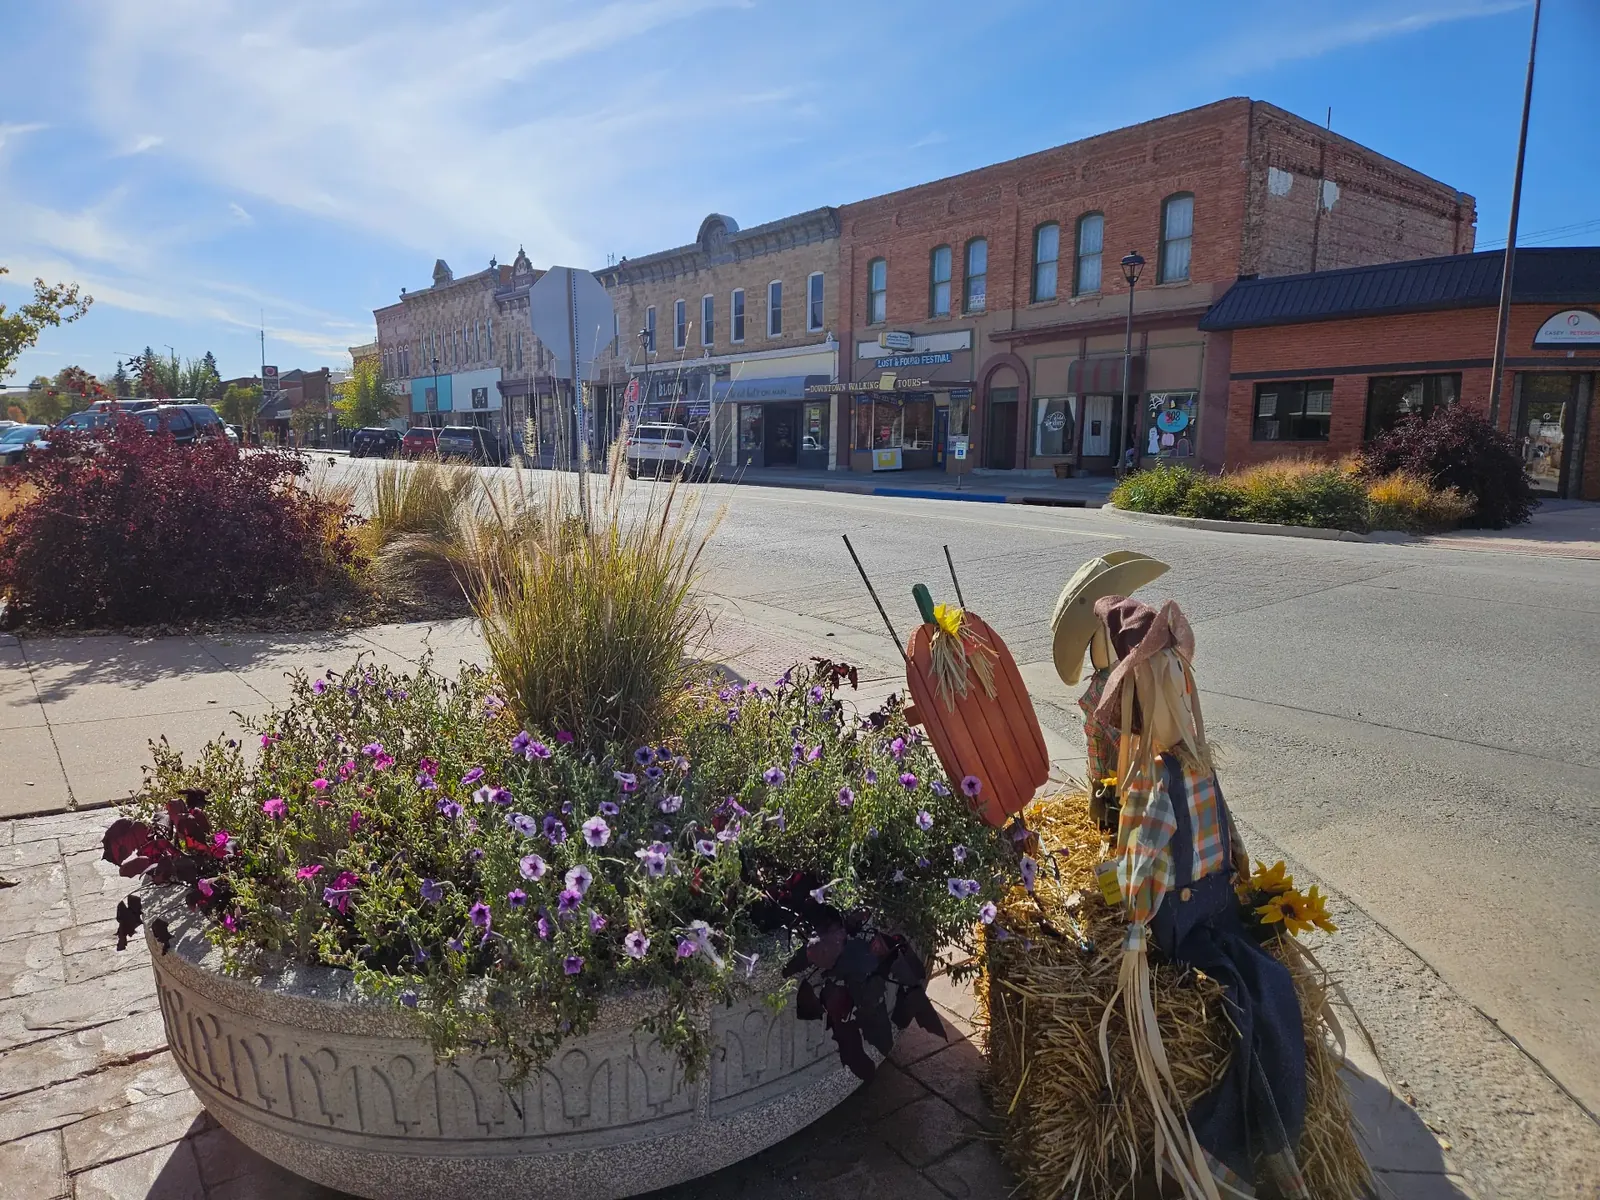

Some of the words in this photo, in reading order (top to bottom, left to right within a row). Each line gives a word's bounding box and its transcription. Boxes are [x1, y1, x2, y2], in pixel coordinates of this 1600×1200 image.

[878, 358, 892, 368] LOST
[921, 353, 951, 364] FESTIVAL
[810, 383, 846, 393] DOWNTOWN
[849, 381, 880, 391] WALKING
[898, 378, 921, 388] TOURS
